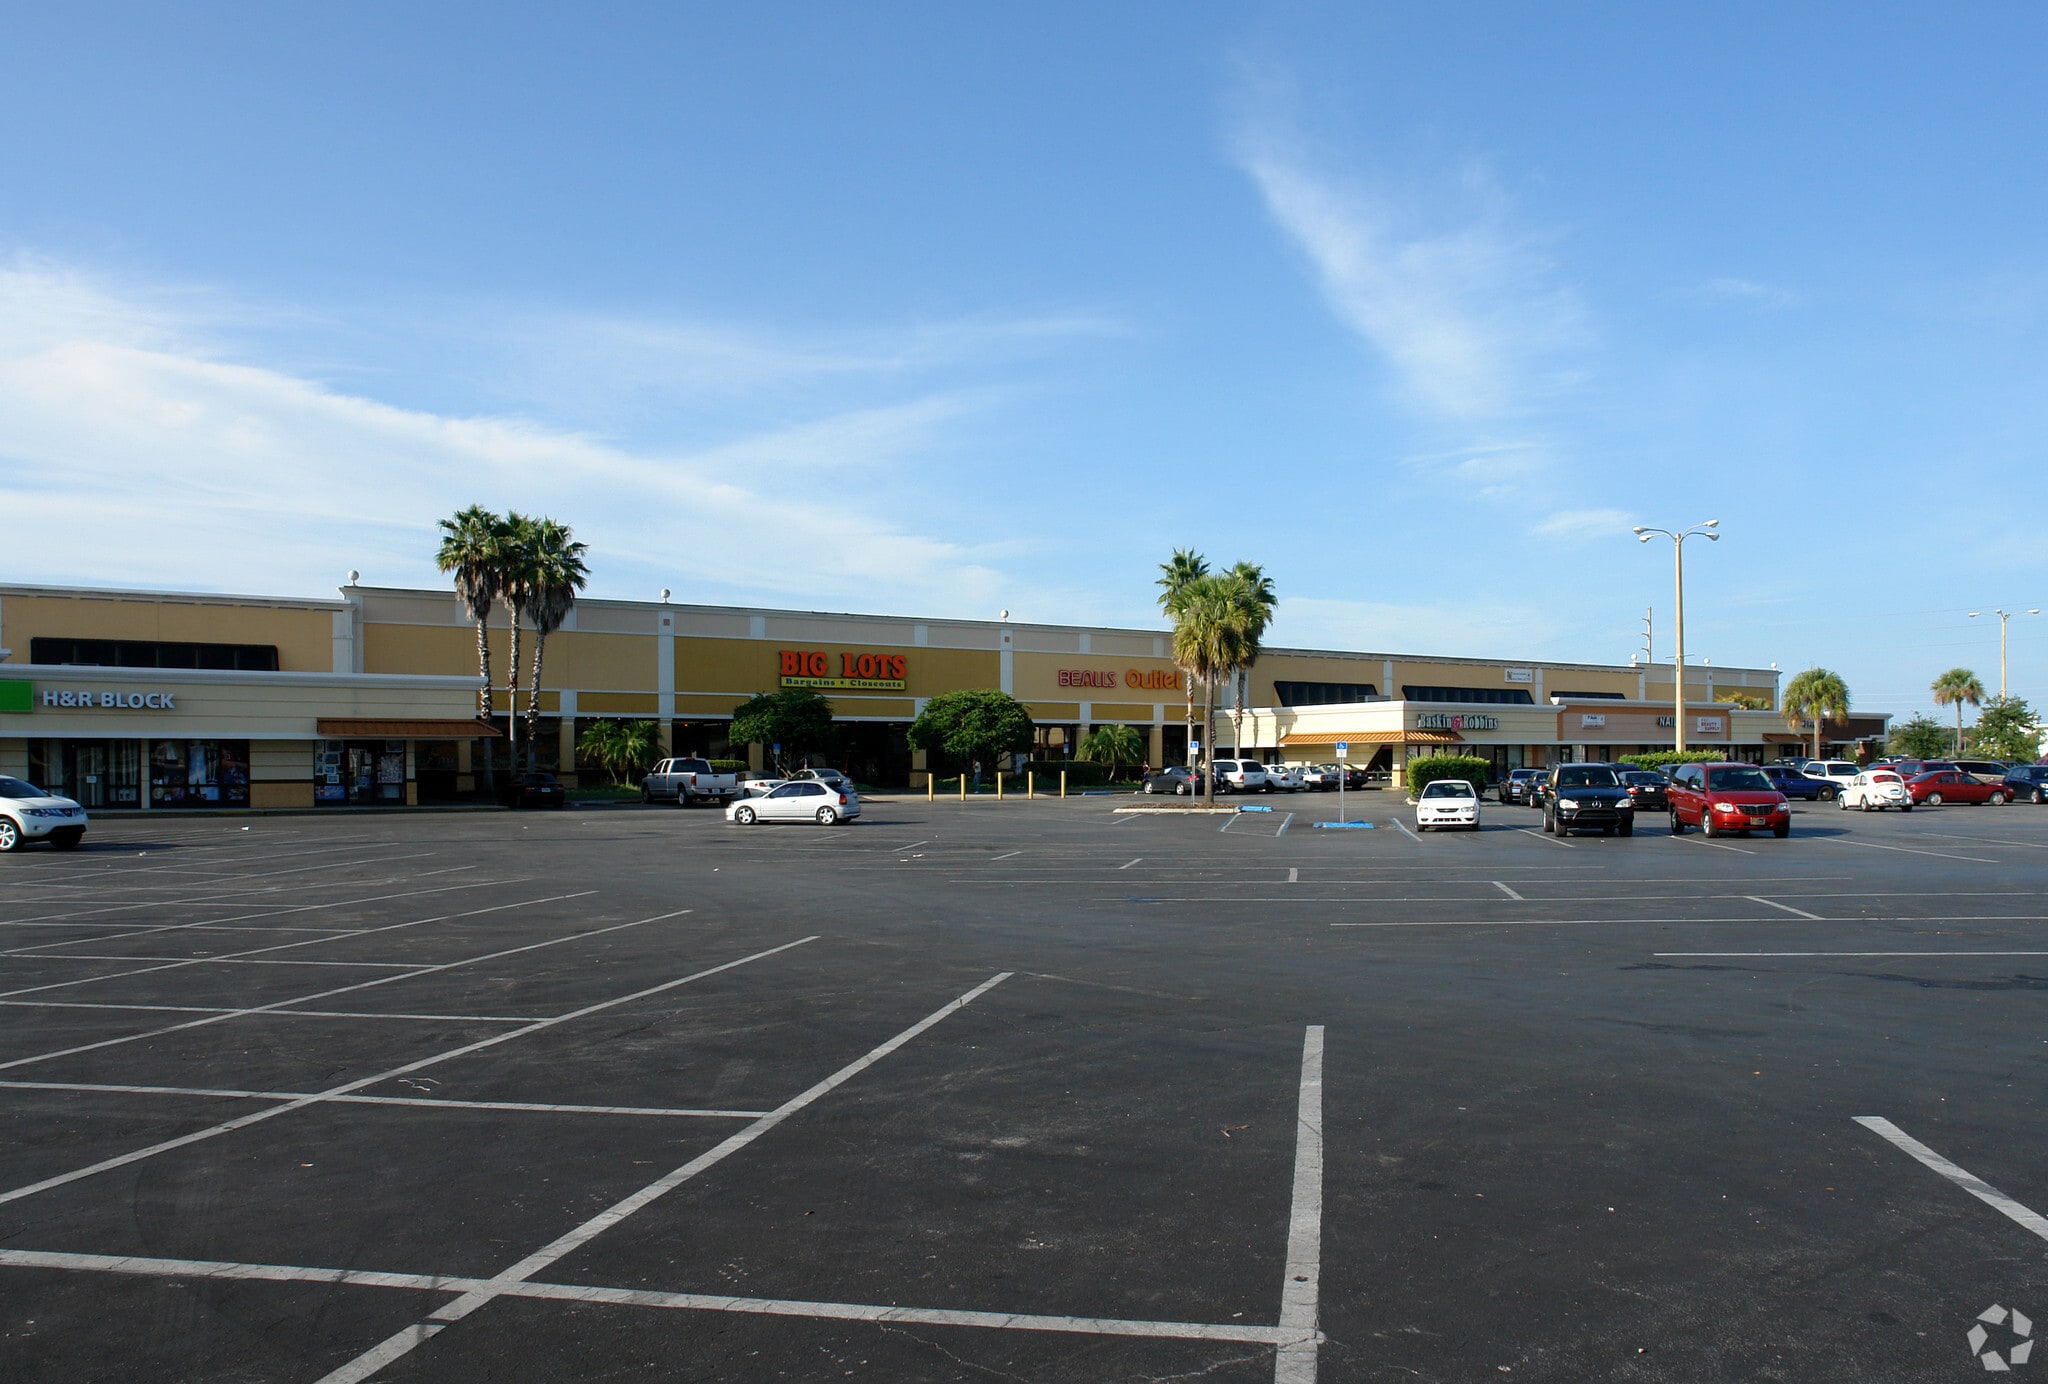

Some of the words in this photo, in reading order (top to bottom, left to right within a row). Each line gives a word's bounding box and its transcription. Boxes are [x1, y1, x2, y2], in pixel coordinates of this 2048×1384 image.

[780, 650, 828, 677] BIG
[841, 652, 906, 679] LOTS
[785, 678, 835, 687] Bargains
[850, 679, 902, 688] Closeouts
[1059, 670, 1116, 688] BEALLS
[1125, 669, 1183, 689] Outlet
[42, 690, 93, 707] H&R
[101, 692, 175, 709] BLOCK
[1417, 714, 1452, 728] Baskin
[1463, 715, 1498, 729] Robbins
[1658, 716, 1677, 727] NAI
